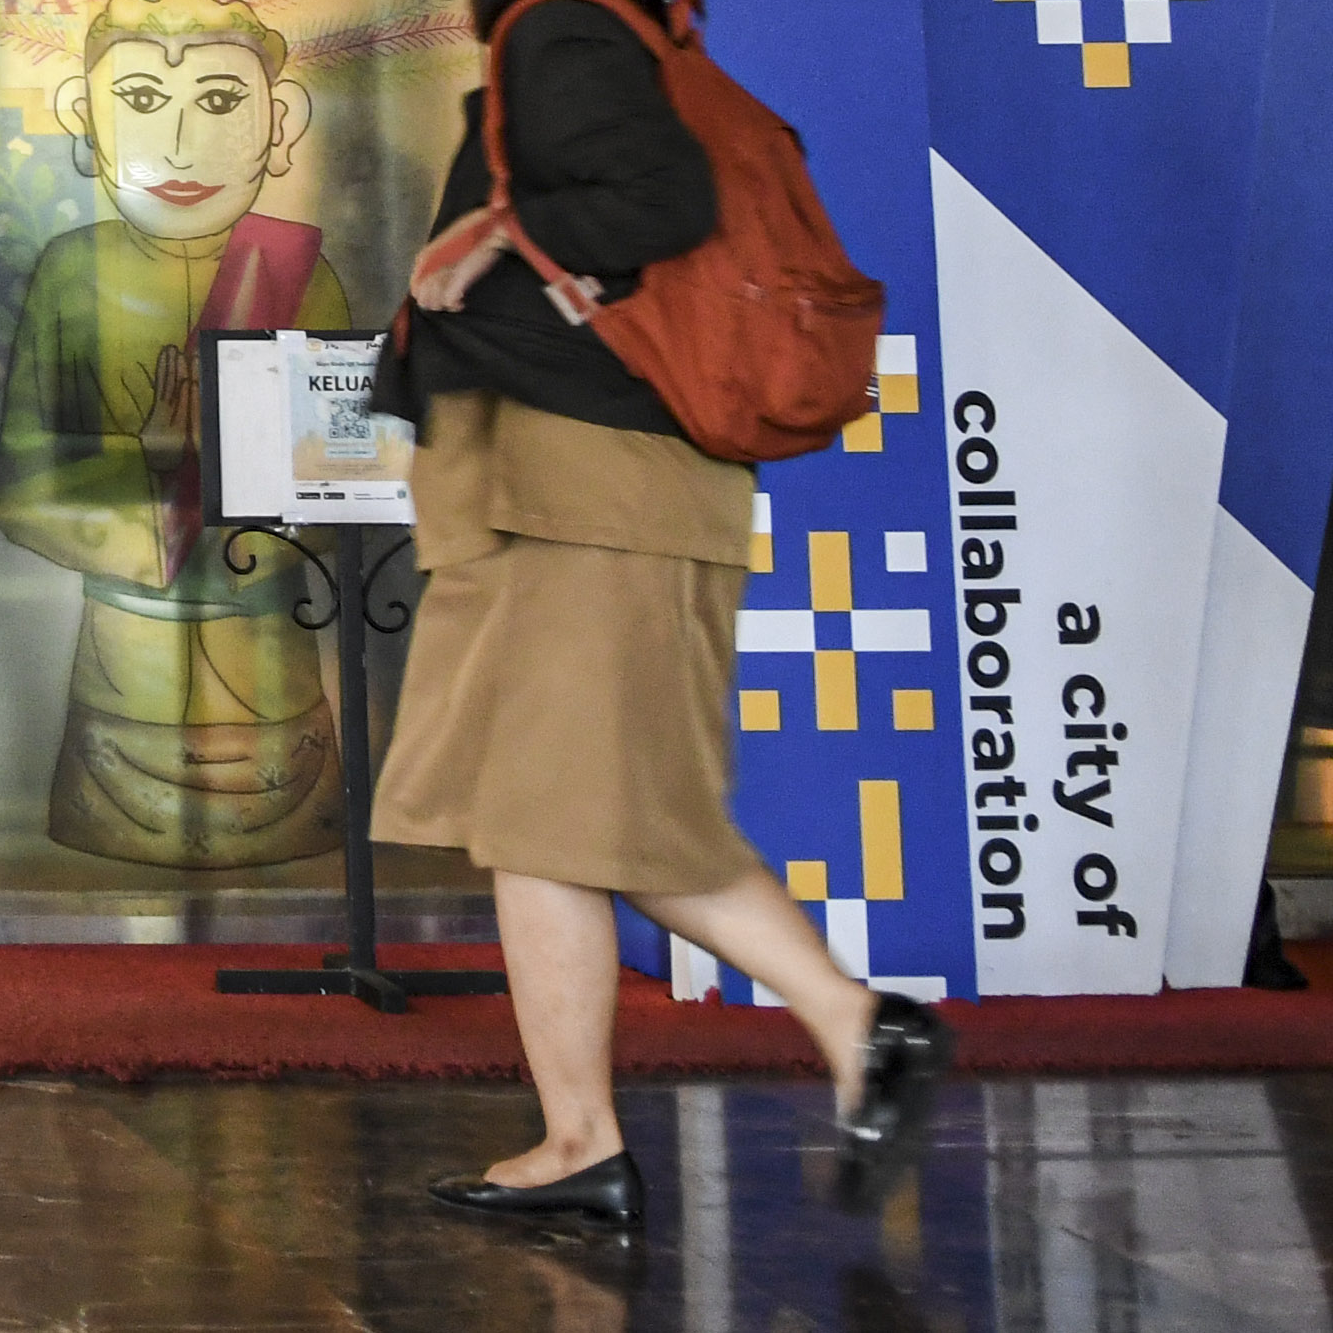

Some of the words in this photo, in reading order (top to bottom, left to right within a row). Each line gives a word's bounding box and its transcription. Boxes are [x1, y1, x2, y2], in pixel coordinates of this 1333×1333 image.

[308, 375, 374, 392] KELUA
[953, 390, 1039, 941] collaboration
[1058, 602, 1102, 645] a
[1053, 673, 1128, 829] city
[1073, 852, 1138, 939] of
